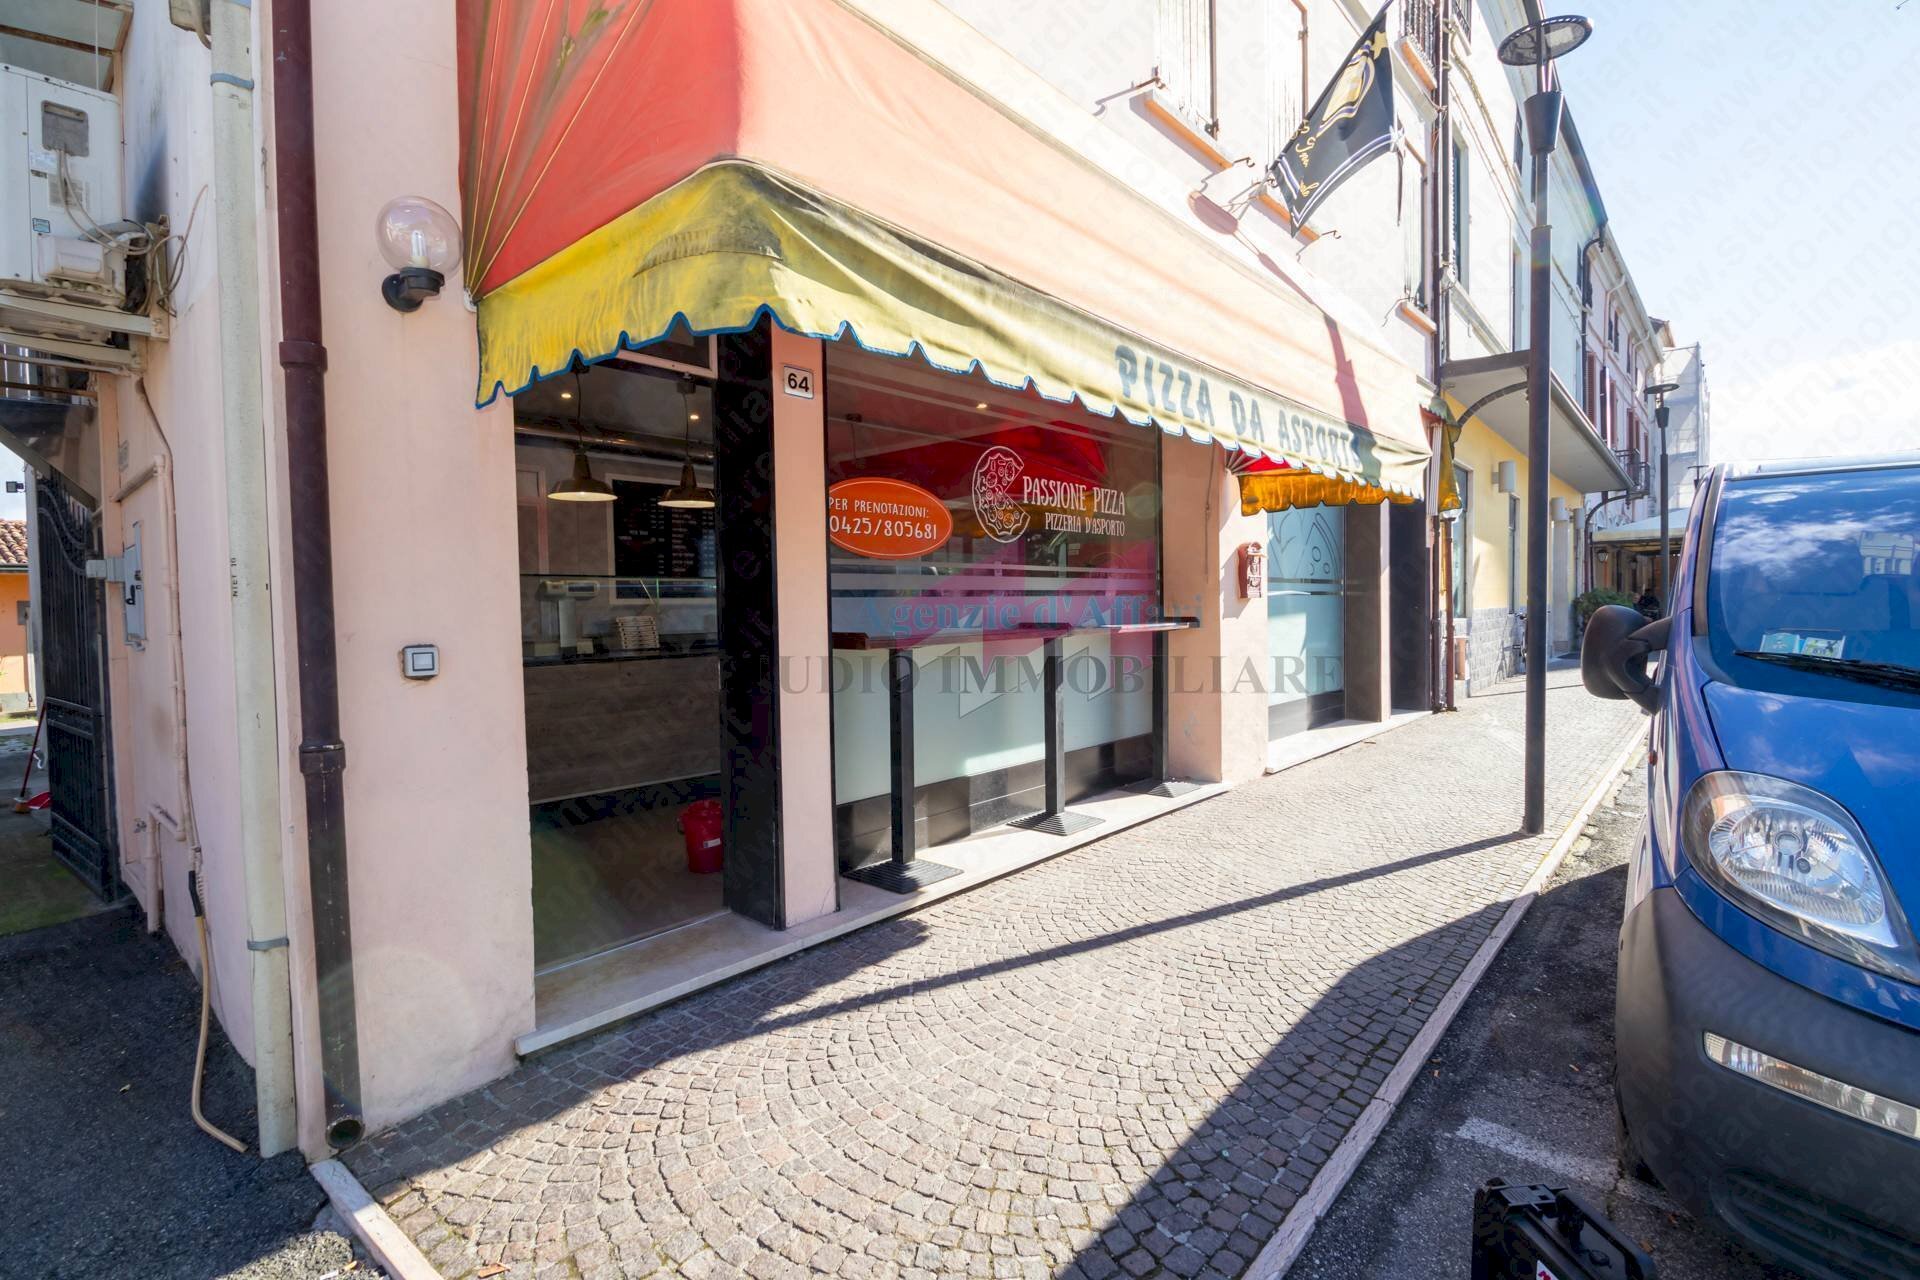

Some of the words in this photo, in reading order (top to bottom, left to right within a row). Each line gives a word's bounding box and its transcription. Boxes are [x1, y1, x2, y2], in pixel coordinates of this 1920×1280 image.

[788, 372, 810, 392] 64
[1115, 345, 1215, 427] PIZZA
[1229, 390, 1264, 444] DA
[829, 496, 848, 511] PER
[854, 499, 929, 519] PRENOTAZIONI:
[1023, 475, 1087, 512] PASSIONE
[1092, 487, 1126, 516] PIZZA
[829, 515, 937, 540] 0425/805681
[1045, 513, 1082, 533] PIZZERIA
[1085, 517, 1125, 536] D'ASPORTO
